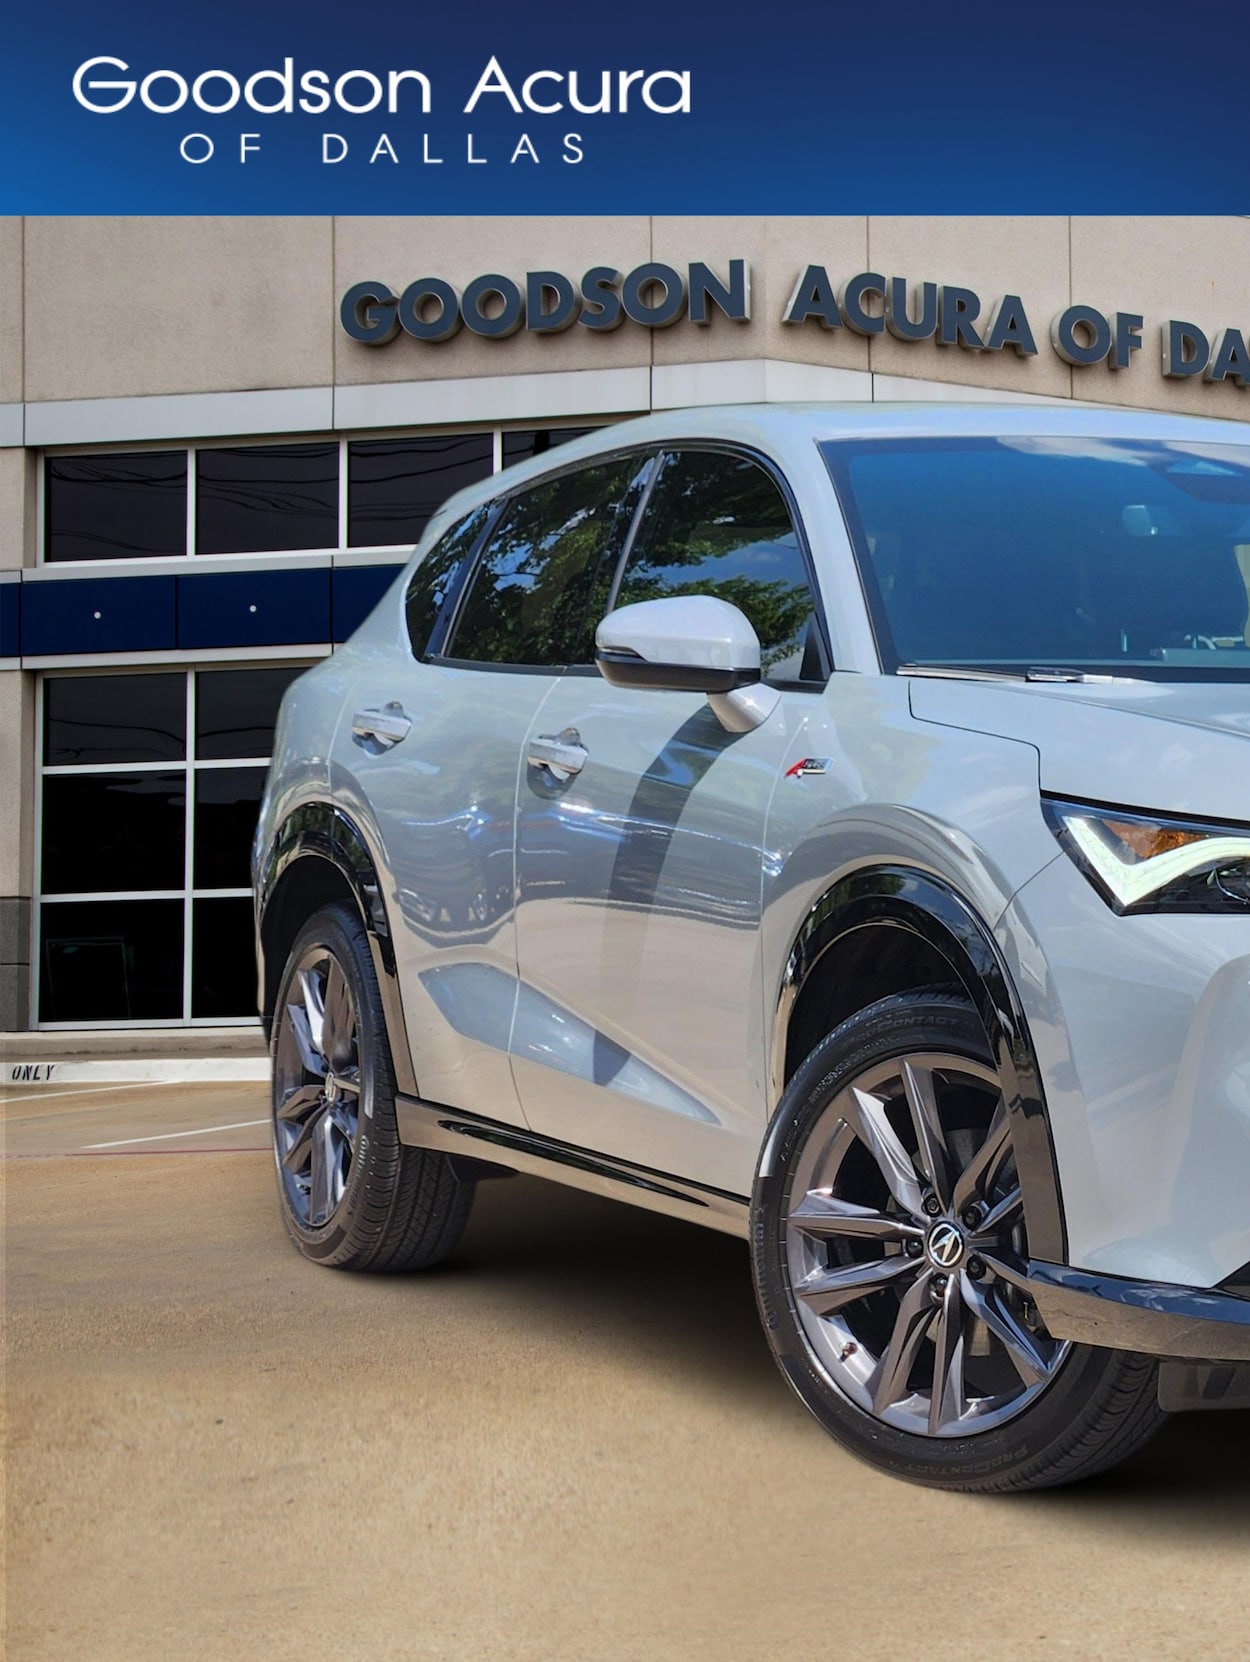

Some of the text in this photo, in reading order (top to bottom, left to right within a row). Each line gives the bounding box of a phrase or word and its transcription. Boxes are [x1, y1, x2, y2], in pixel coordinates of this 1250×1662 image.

[340, 259, 752, 346] GOODSON
[782, 264, 1039, 357] ACURA
[1050, 305, 1144, 370] OF
[12, 1065, 54, 1081] ONLY
